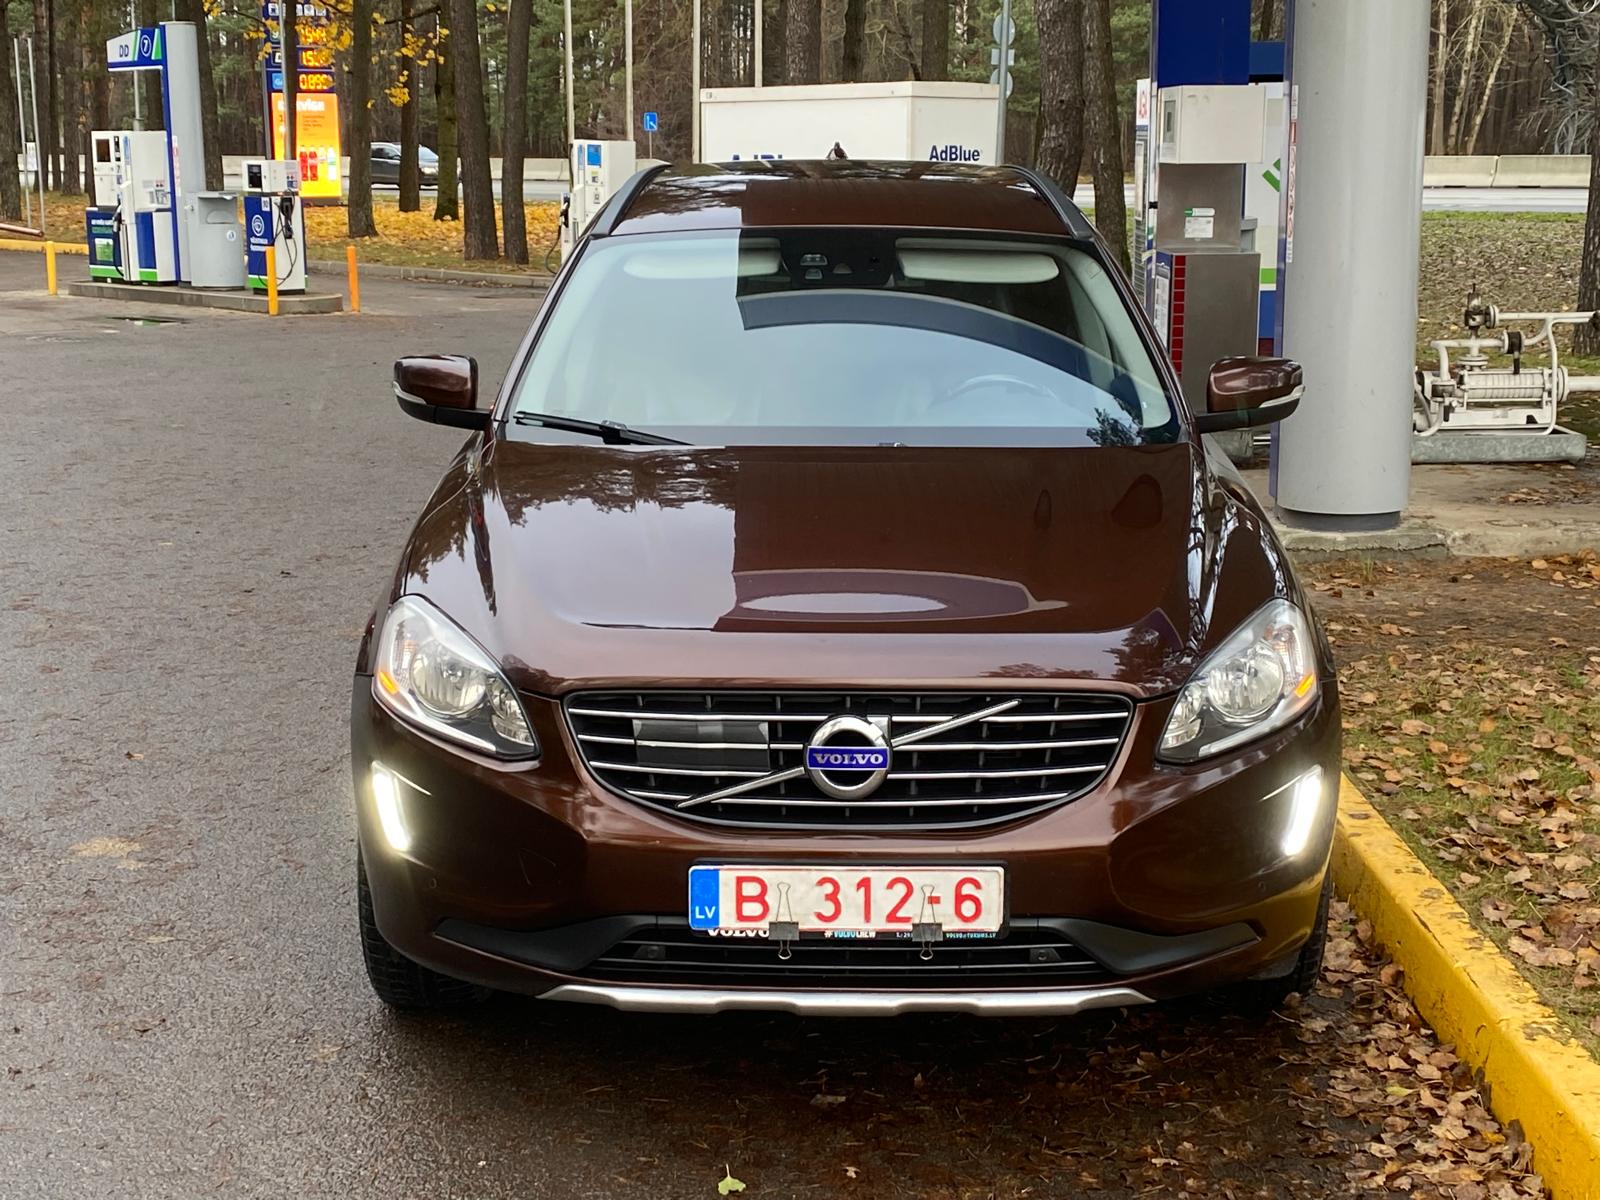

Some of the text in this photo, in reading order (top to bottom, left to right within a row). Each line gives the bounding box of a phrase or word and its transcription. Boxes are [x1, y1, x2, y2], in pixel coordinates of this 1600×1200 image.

[119, 44, 129, 58] DD
[143, 39, 149, 52] 7
[929, 145, 980, 162] AdBlue
[813, 753, 884, 765] VOLVO
[735, 876, 983, 923] B 312-6
[695, 905, 716, 919] LV
